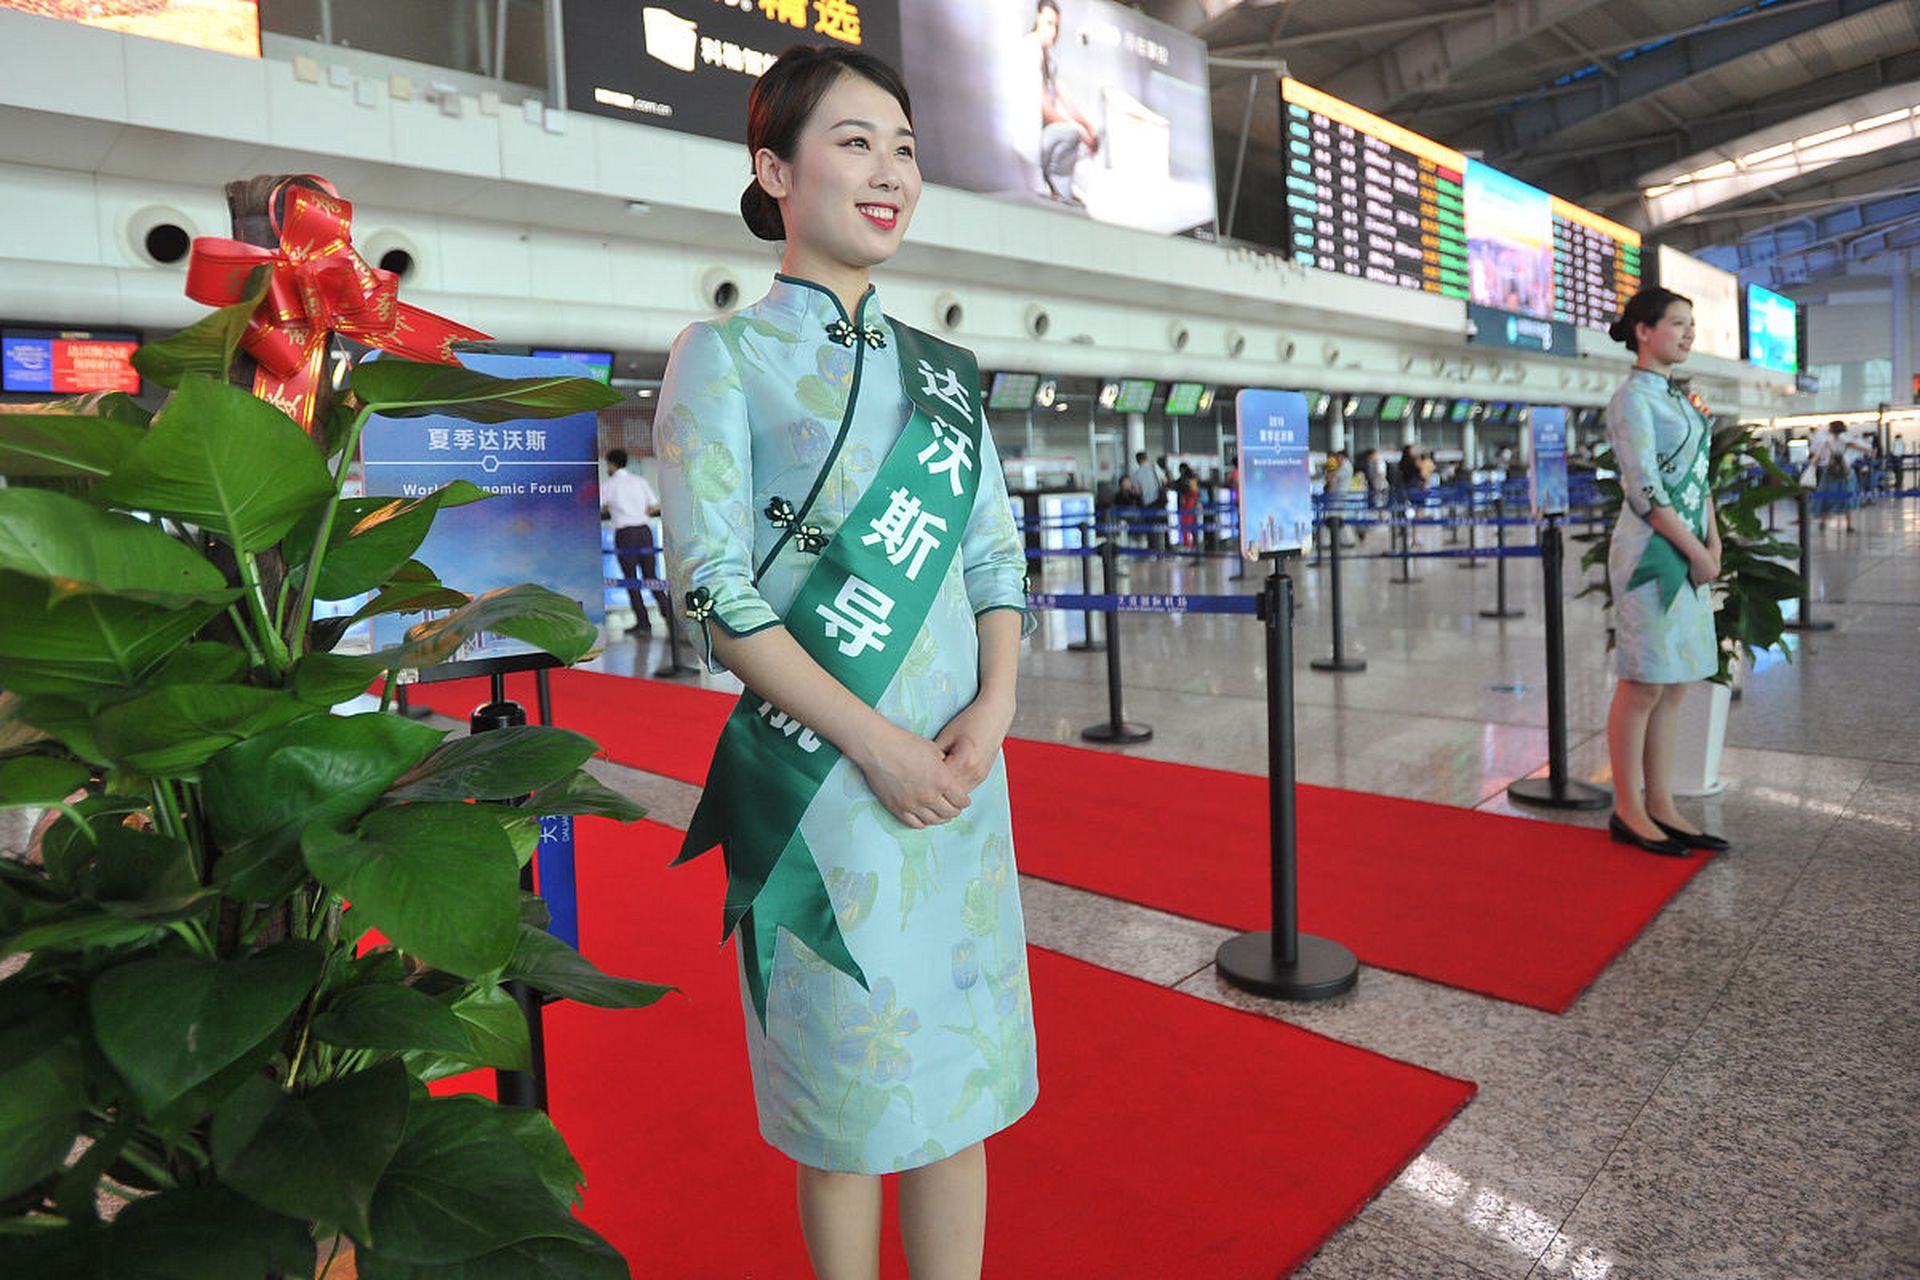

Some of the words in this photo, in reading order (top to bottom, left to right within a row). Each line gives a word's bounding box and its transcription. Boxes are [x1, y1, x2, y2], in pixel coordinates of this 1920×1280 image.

[427, 428, 547, 451] 夏季达沃斯
[402, 484, 439, 496] Worl
[530, 482, 573, 495] Forum
